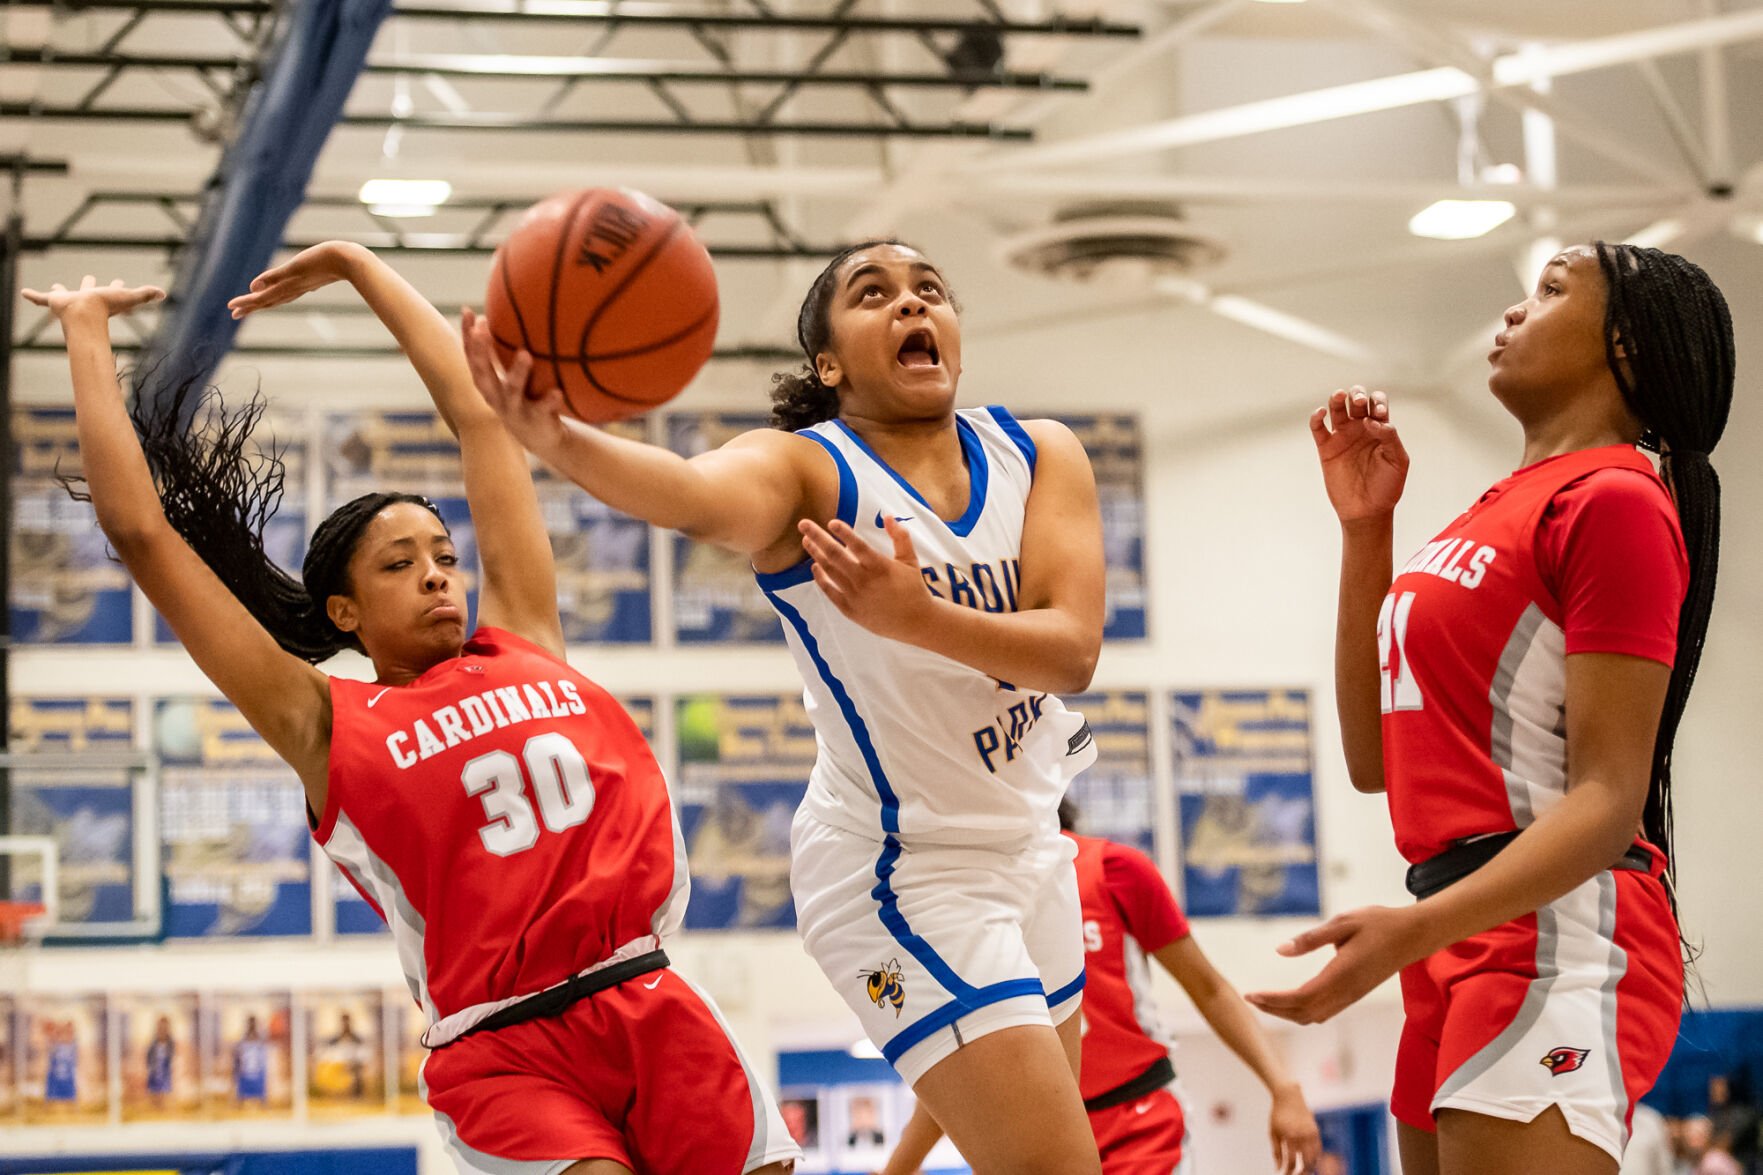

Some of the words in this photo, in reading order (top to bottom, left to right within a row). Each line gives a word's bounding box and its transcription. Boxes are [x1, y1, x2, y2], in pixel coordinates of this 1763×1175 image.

[385, 679, 587, 769] CARDINALS
[973, 693, 1047, 774] PARK
[460, 731, 596, 858] 30
